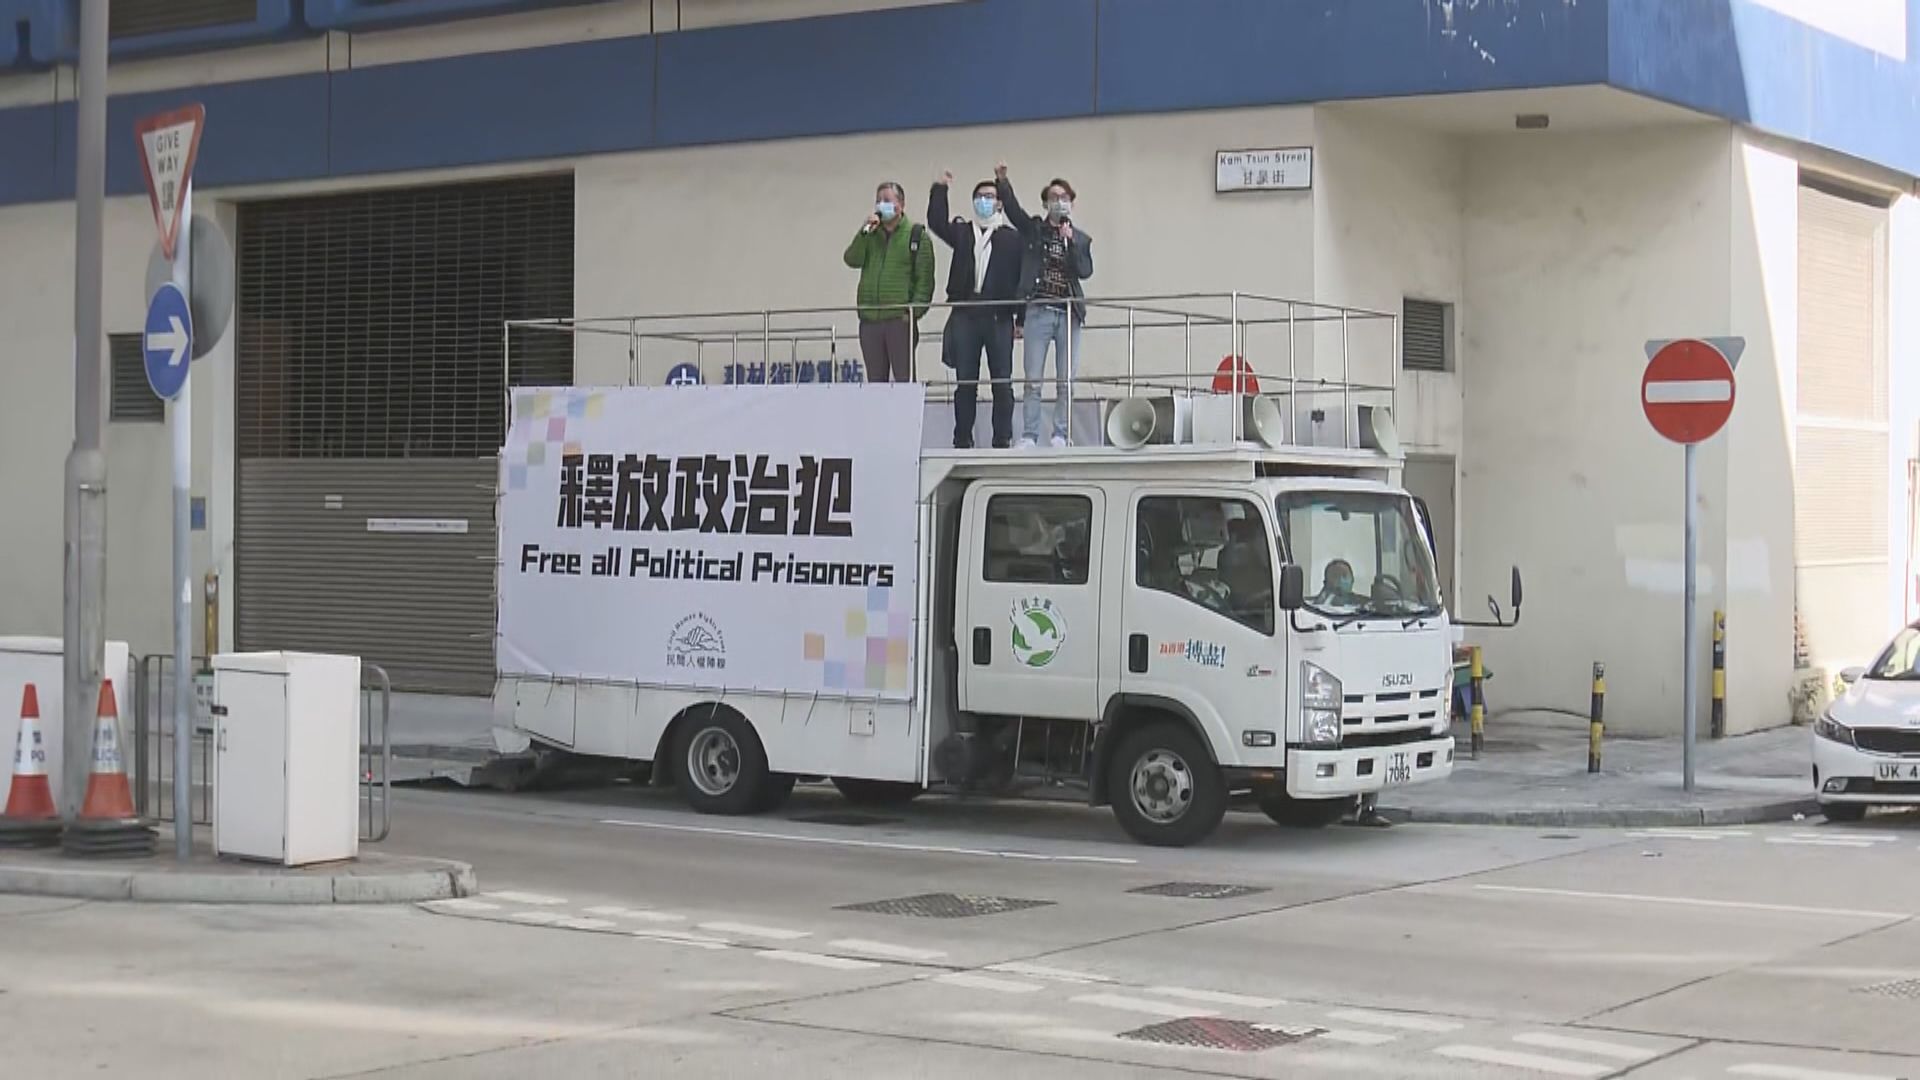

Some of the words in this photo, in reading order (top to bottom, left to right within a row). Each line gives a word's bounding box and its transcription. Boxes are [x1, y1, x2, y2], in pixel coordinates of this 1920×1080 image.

[156, 130, 180, 153] GIVE
[158, 156, 178, 173] WAY
[1275, 152, 1307, 163] Street
[557, 454, 853, 537] 釋放政治犯
[520, 544, 581, 575] Free
[591, 547, 622, 576] all
[629, 548, 743, 583] Political
[752, 552, 894, 587] Prisoners
[666, 654, 726, 669] 民間人權陣線
[1382, 673, 1413, 686] ISUZU
[1879, 764, 1900, 779] UK
